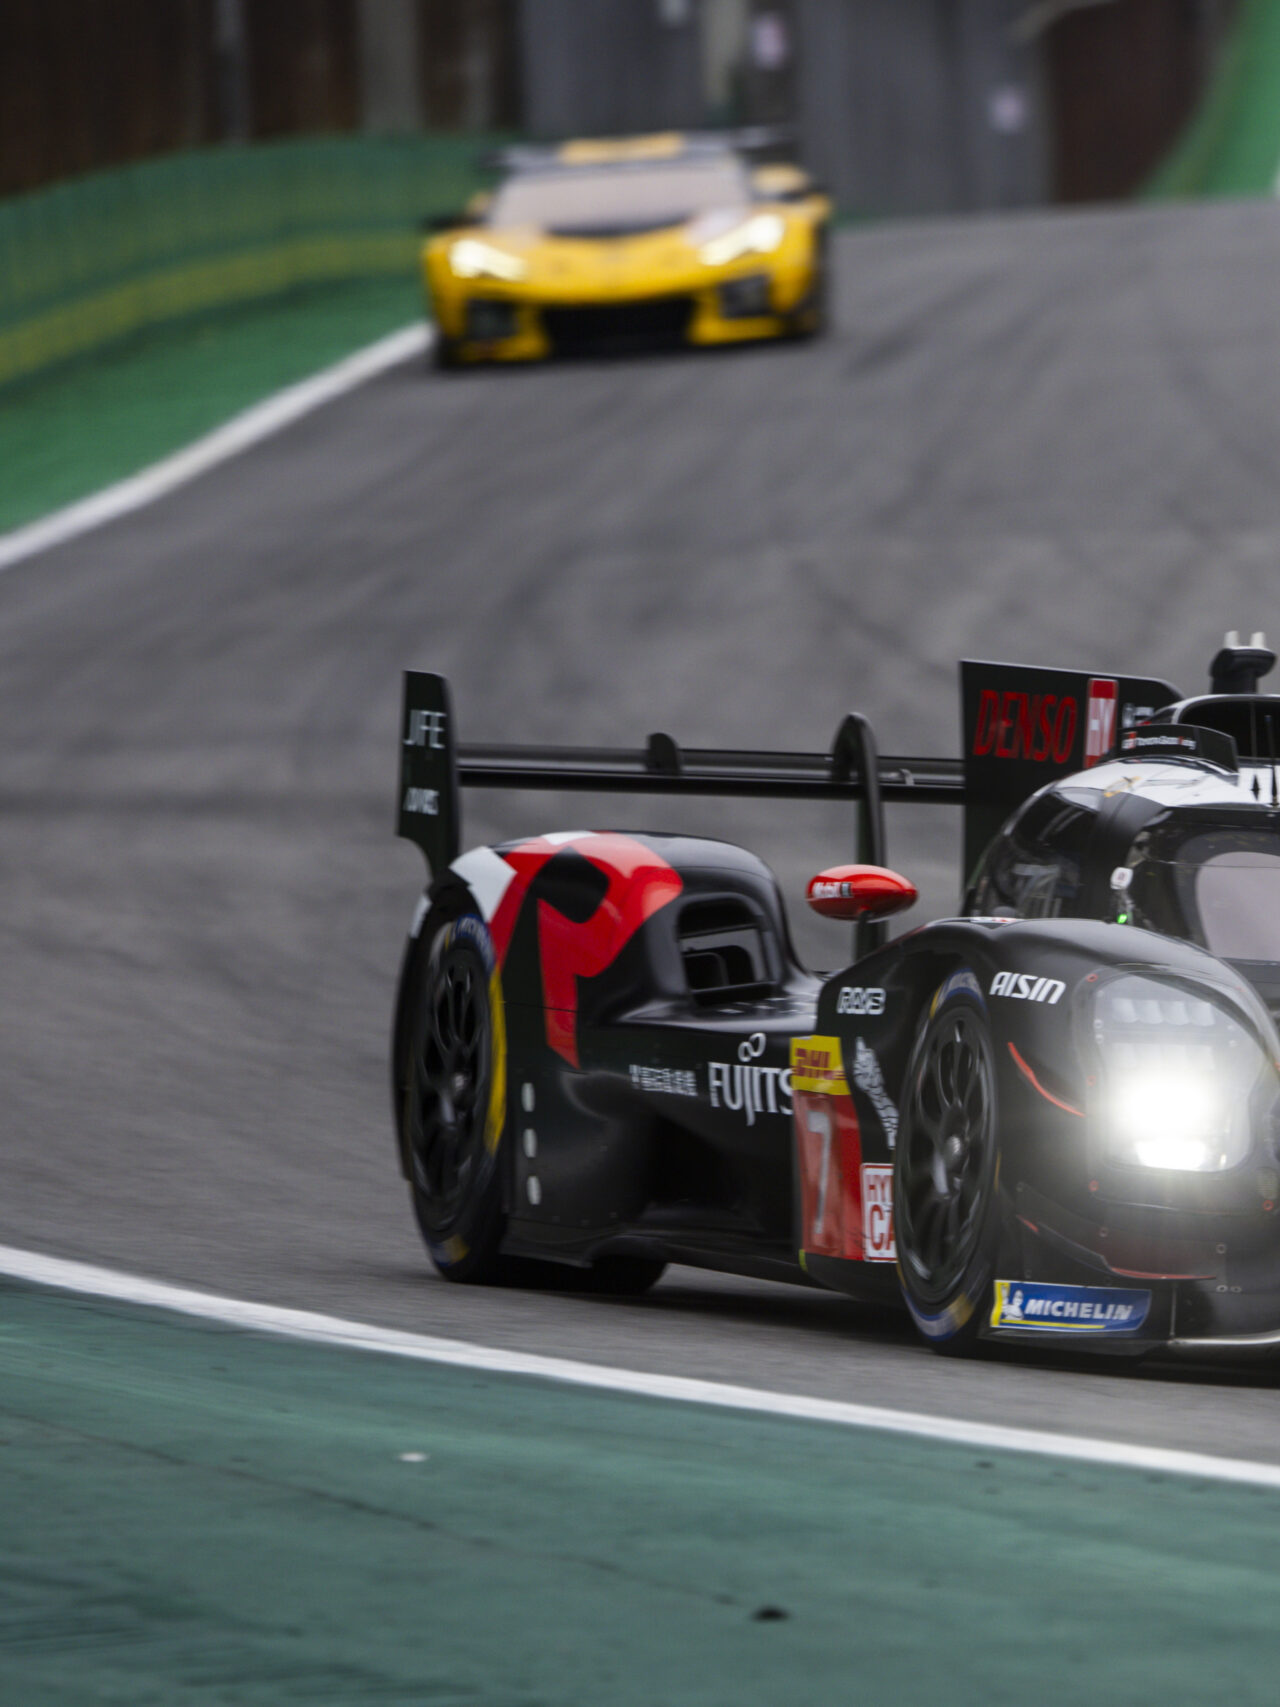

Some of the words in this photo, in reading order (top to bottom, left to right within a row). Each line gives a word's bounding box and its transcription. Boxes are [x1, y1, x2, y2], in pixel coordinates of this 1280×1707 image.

[403, 709, 447, 750] JFE
[972, 689, 1078, 764] DENSO
[1085, 698, 1116, 757] HY
[989, 971, 1067, 1005] AISIN
[807, 1110, 831, 1235] 7
[1024, 1298, 1134, 1321] MICHELIN
